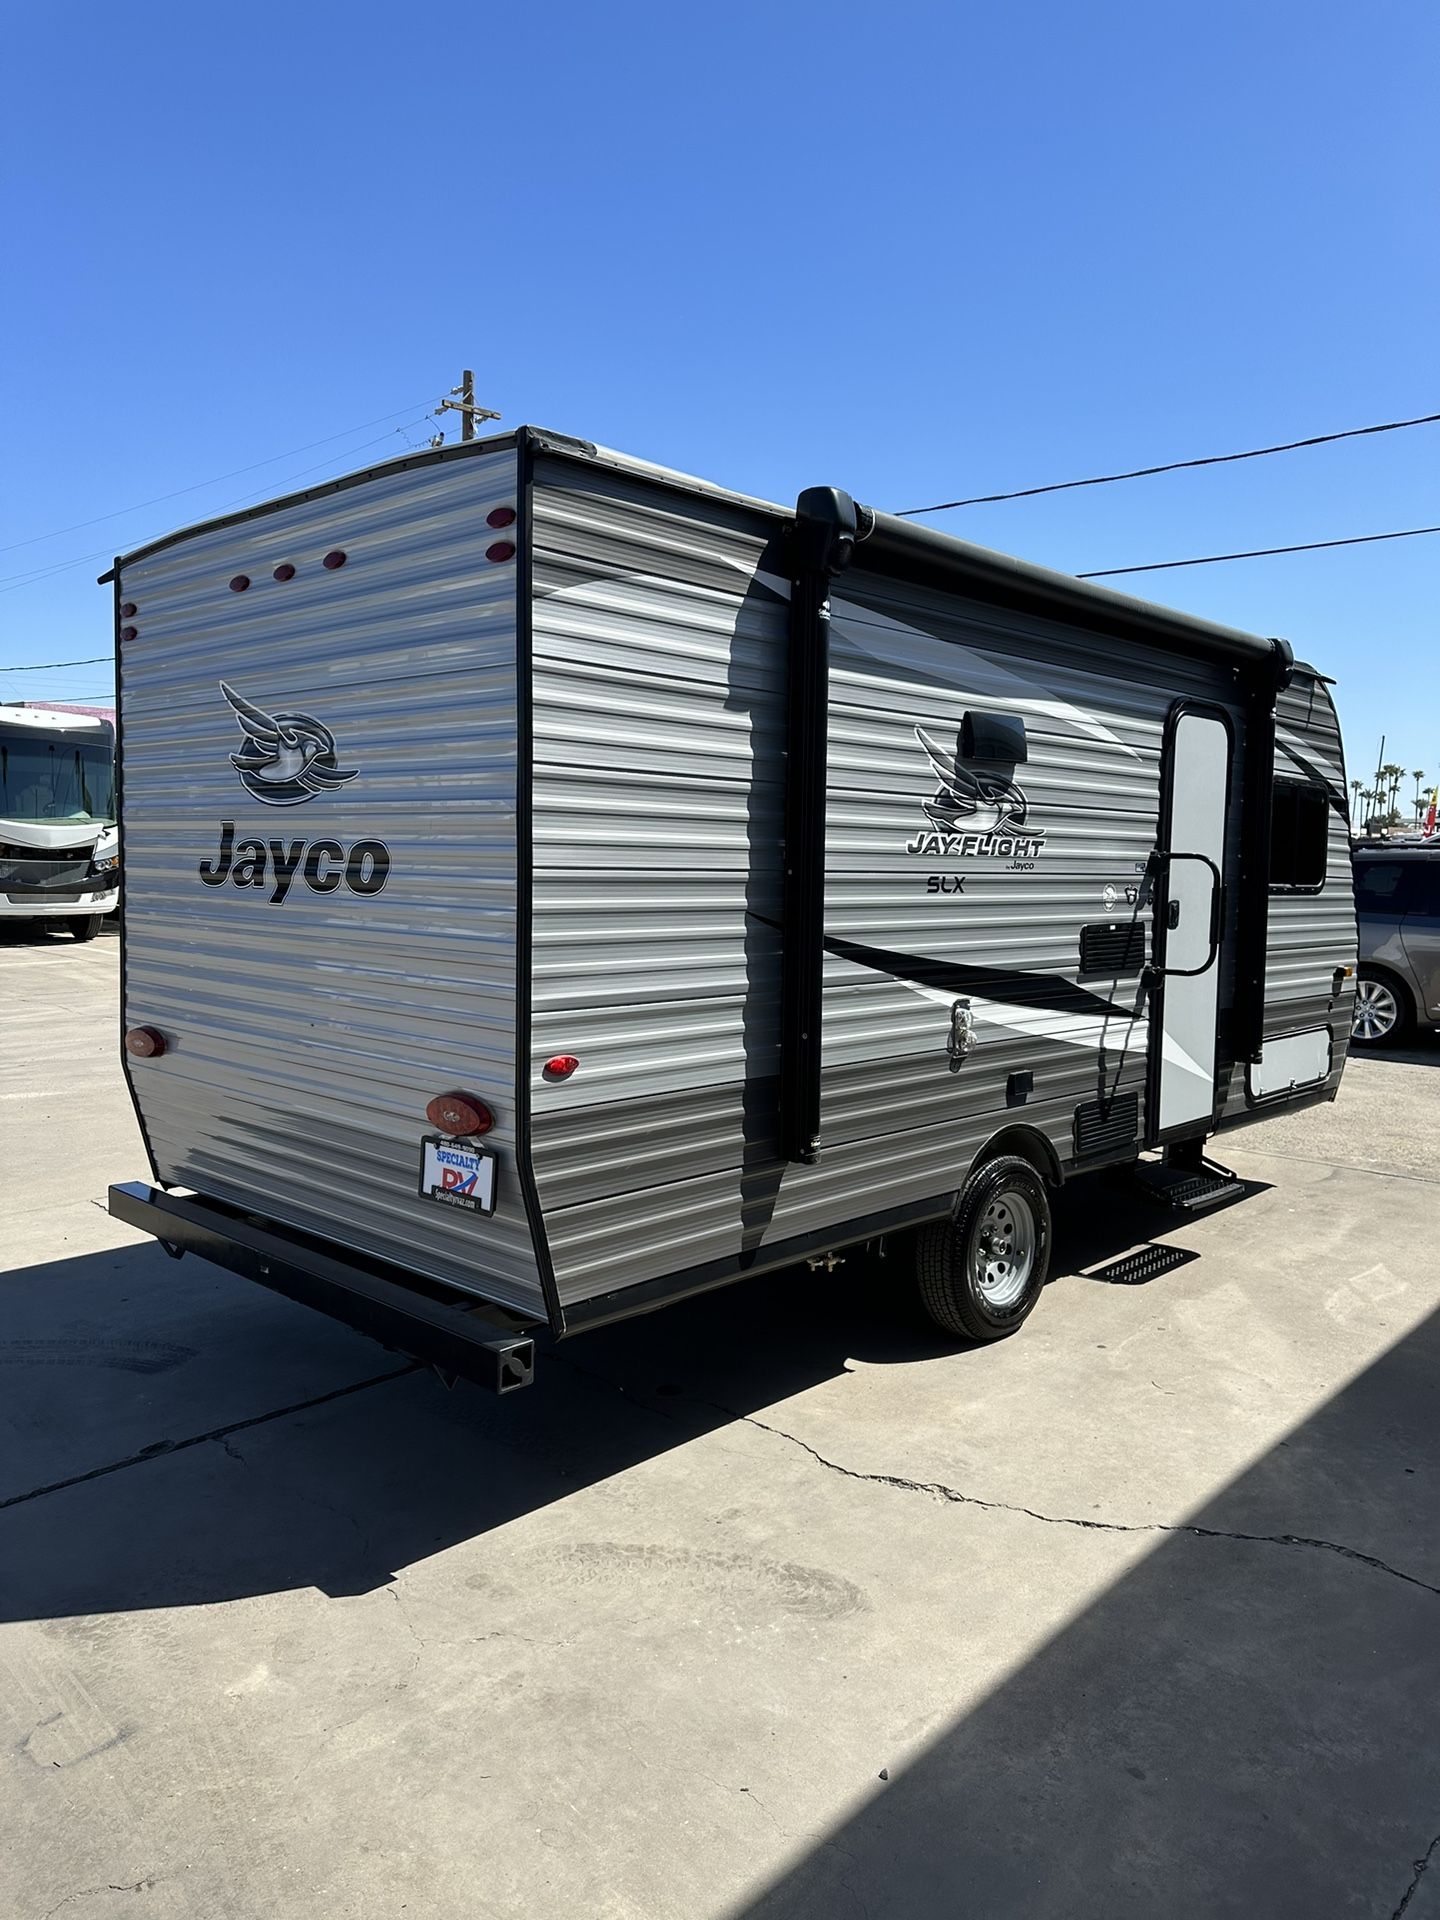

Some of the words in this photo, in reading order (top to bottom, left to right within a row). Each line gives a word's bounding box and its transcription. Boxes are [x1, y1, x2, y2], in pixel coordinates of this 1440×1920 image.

[906, 831, 958, 855] JAY
[959, 834, 1047, 858] FLIGHT
[199, 819, 392, 906] Jayco
[1010, 860, 1034, 871] Jayco
[926, 875, 966, 894] SLX
[436, 1150, 481, 1171] SPECIALTY
